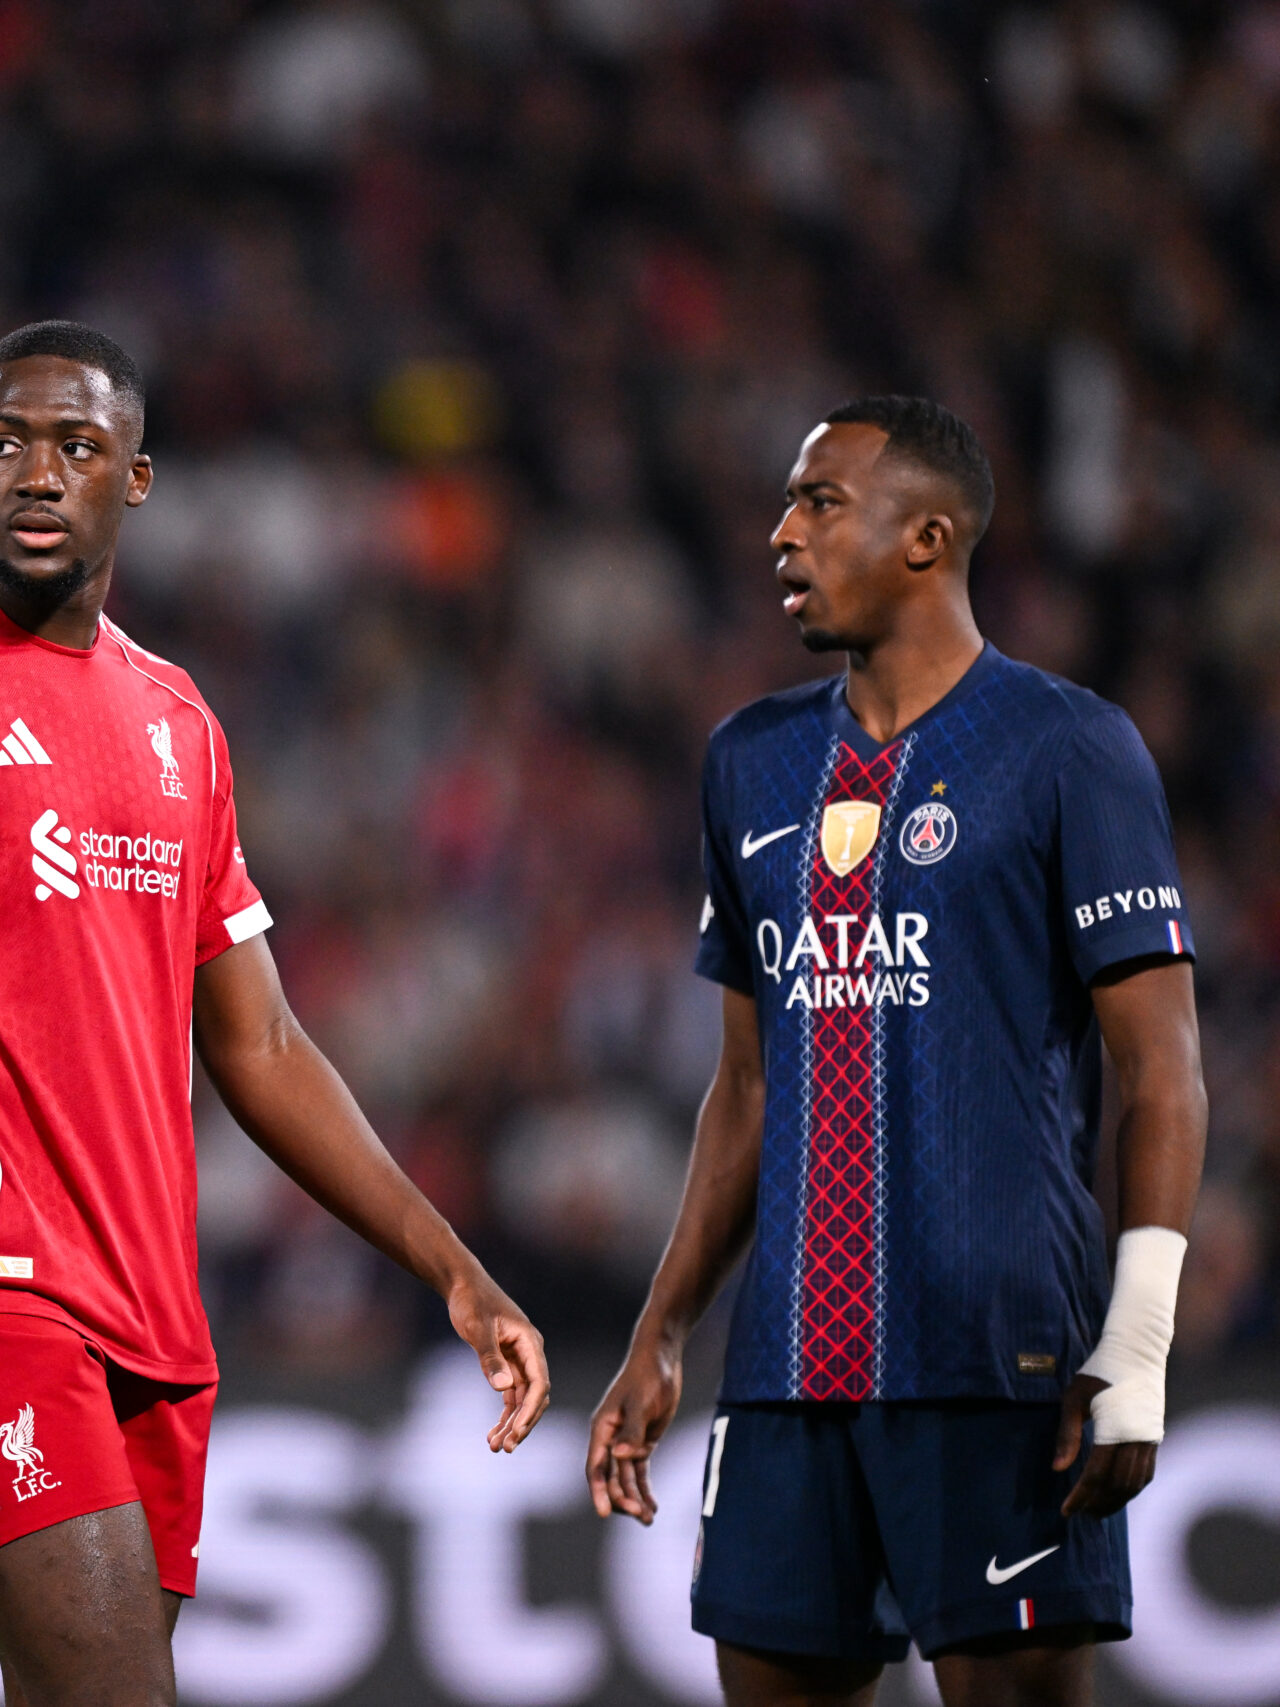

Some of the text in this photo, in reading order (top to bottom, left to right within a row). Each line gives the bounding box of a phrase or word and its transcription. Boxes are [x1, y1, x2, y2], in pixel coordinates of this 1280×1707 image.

[914, 805, 950, 823] PARIS
[80, 827, 183, 868] standard
[86, 859, 180, 900] chartered
[757, 911, 932, 985] QATAR
[785, 972, 931, 1010] AIRWAYS
[12, 1471, 62, 1503] L.F.C.
